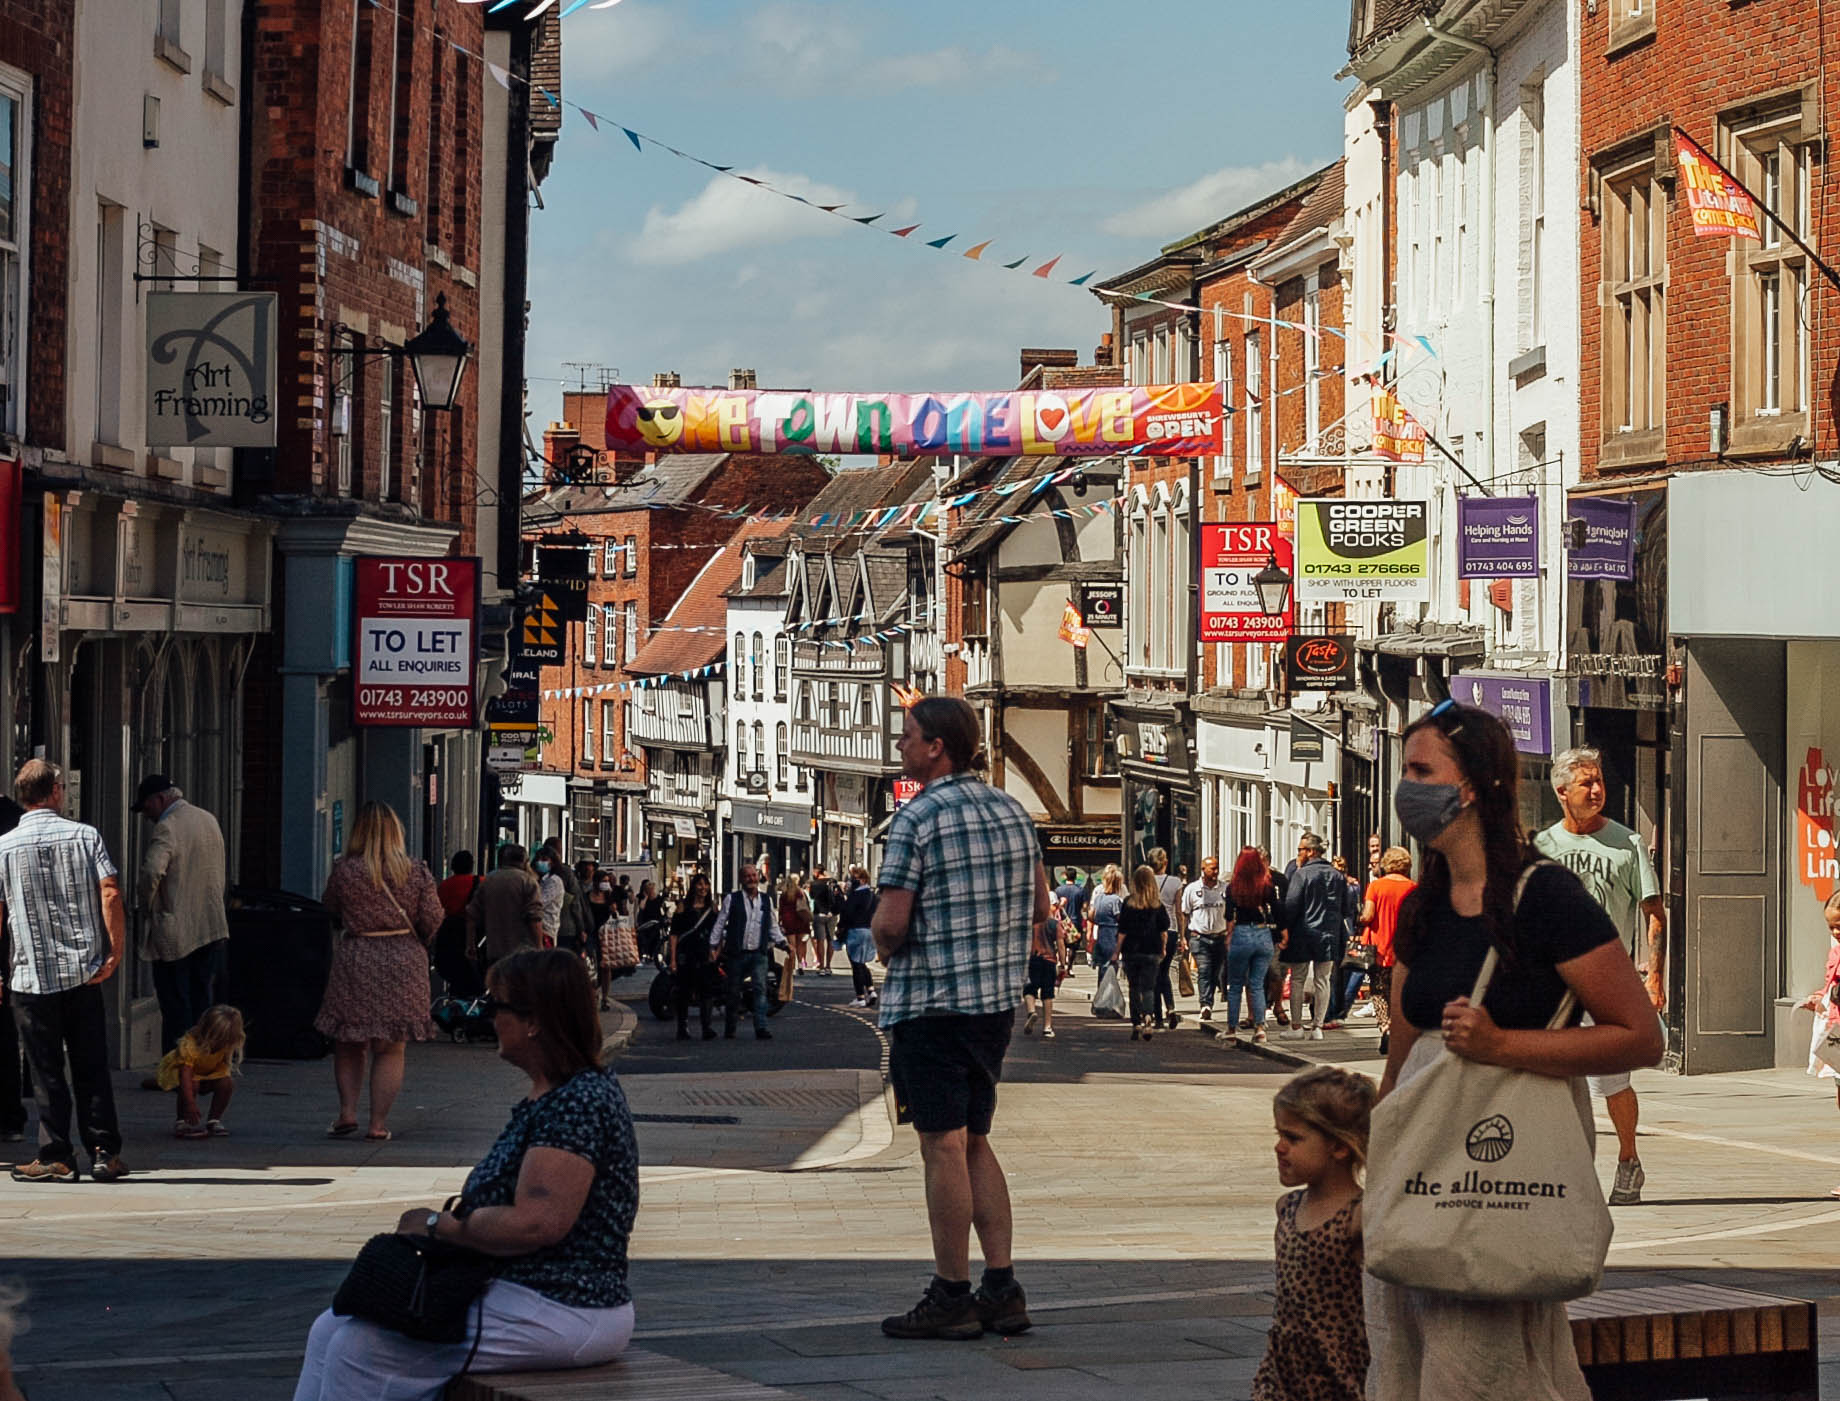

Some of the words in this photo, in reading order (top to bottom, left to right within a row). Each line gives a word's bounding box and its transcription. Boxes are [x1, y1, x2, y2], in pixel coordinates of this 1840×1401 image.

[186, 362, 232, 391] Art
[155, 389, 272, 424] Framing
[1146, 418, 1213, 439] OPEN
[1329, 504, 1422, 518] COOPER
[1328, 519, 1405, 533] GREEN
[1464, 524, 1502, 538] Helping
[1502, 523, 1533, 535] Hands
[1217, 527, 1273, 551] TSR
[1330, 533, 1405, 547] POOKS
[1304, 564, 1352, 574] 01743
[1358, 564, 1420, 574] 276666
[1465, 562, 1494, 572] 01743
[1497, 562, 1513, 571] 404
[1515, 562, 1533, 571] 695
[379, 563, 454, 595] TSR
[1214, 573, 1239, 586] TO
[1308, 579, 1331, 587] SHOP
[1334, 579, 1353, 587] WITH
[1355, 579, 1381, 587] UPPER
[1384, 579, 1417, 587] FLOORS
[1343, 588, 1358, 598] TO
[1361, 588, 1382, 598] LET
[1209, 616, 1239, 629] 01743
[1243, 616, 1284, 629] 243900
[1204, 629, 1289, 639] www.tsrsurveyors.co.uk
[369, 630, 406, 652] TO
[417, 631, 462, 653] LET
[1305, 643, 1339, 662] Taste
[369, 660, 393, 672] ALL
[398, 660, 462, 674] ENQUIRIES
[360, 689, 403, 706] 01743
[410, 690, 468, 707] 243900
[359, 710, 468, 721] www.tsrsurveyors.co.uk
[1806, 763, 1840, 787] Lov
[1806, 823, 1840, 849] Lov
[1806, 851, 1840, 879] Lin
[1404, 1171, 1442, 1196] the
[1450, 1170, 1567, 1198] allotment
[1434, 1199, 1484, 1210] PRODUCE
[1486, 1201, 1531, 1210] MARKET
